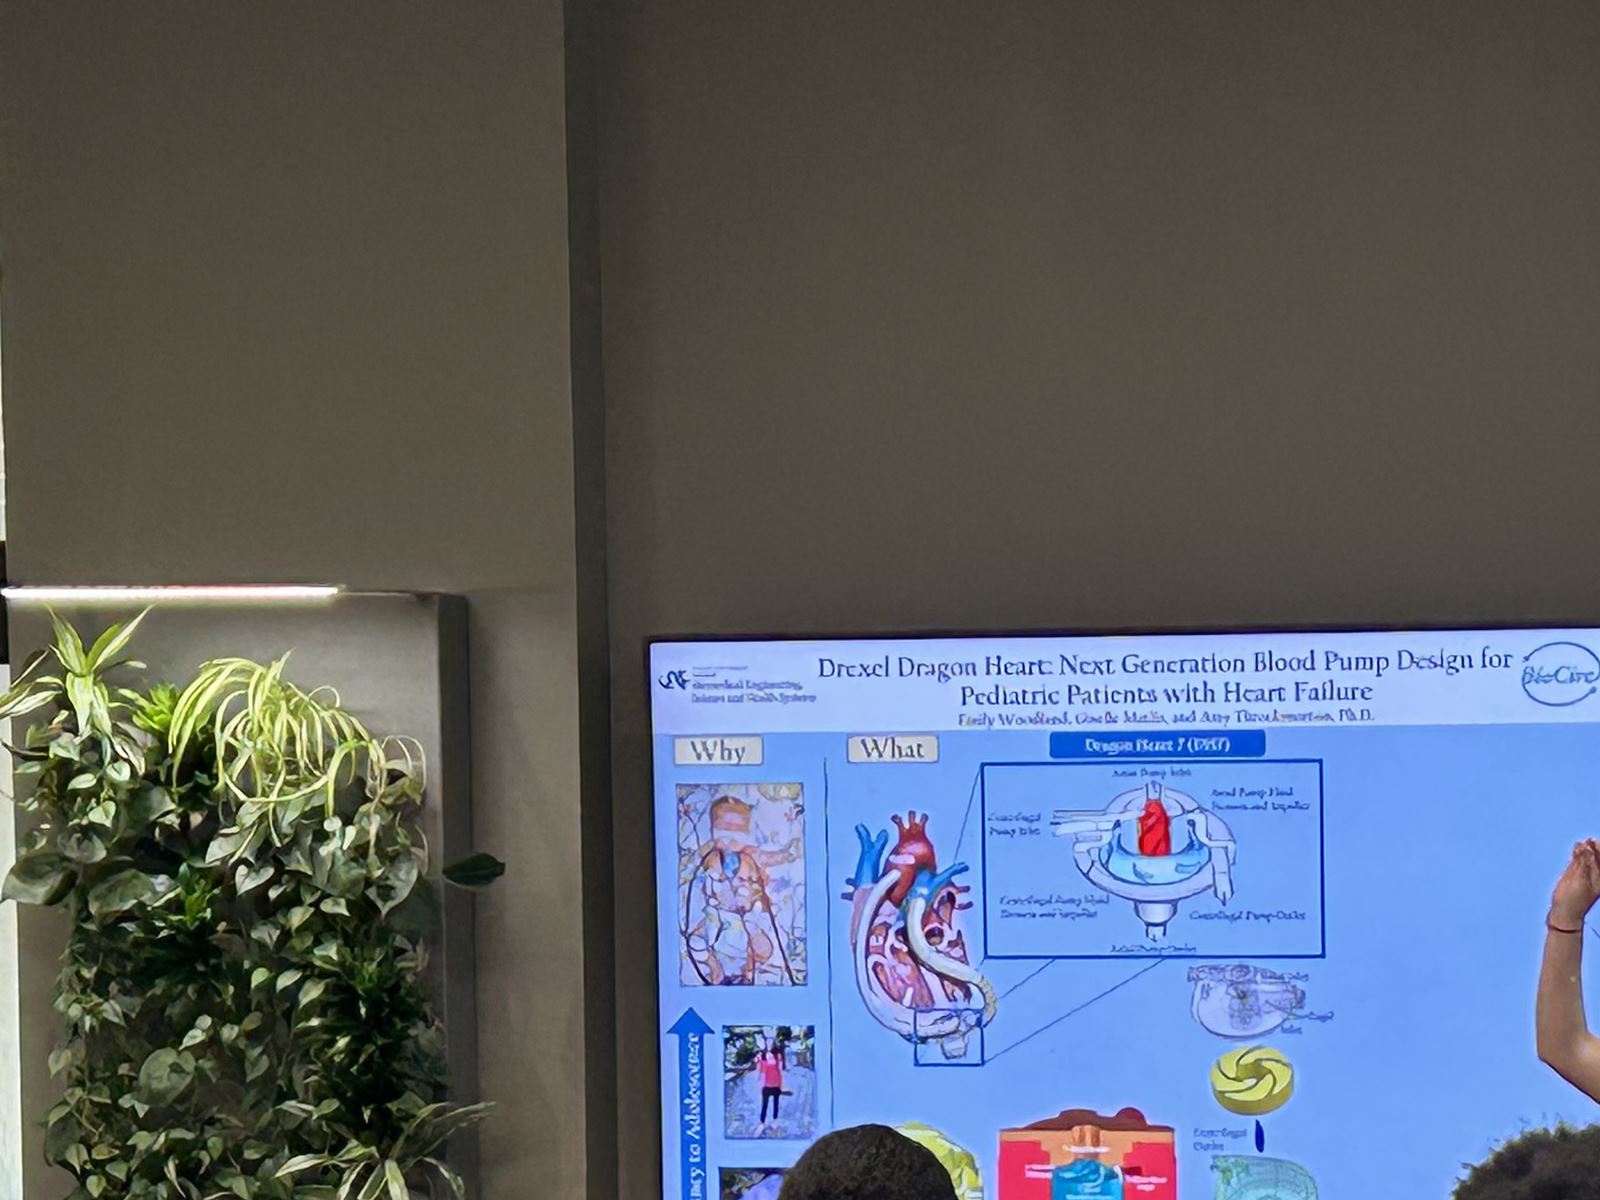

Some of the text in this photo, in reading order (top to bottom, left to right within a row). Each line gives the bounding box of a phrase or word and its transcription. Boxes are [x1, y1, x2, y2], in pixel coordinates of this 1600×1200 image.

[818, 655, 890, 679] Drexel
[898, 656, 978, 684] Dragon
[1060, 654, 1116, 677] Next
[1122, 651, 1246, 676] Generation
[1254, 649, 1317, 673] Blood
[1325, 649, 1390, 678] Pump
[1397, 648, 1474, 677] Design
[1482, 645, 1515, 670] for
[961, 679, 1374, 706] Pediatric Patients with Heart Failure
[690, 738, 747, 765] Why
[860, 736, 926, 761] What
[688, 1143, 702, 1164] to
